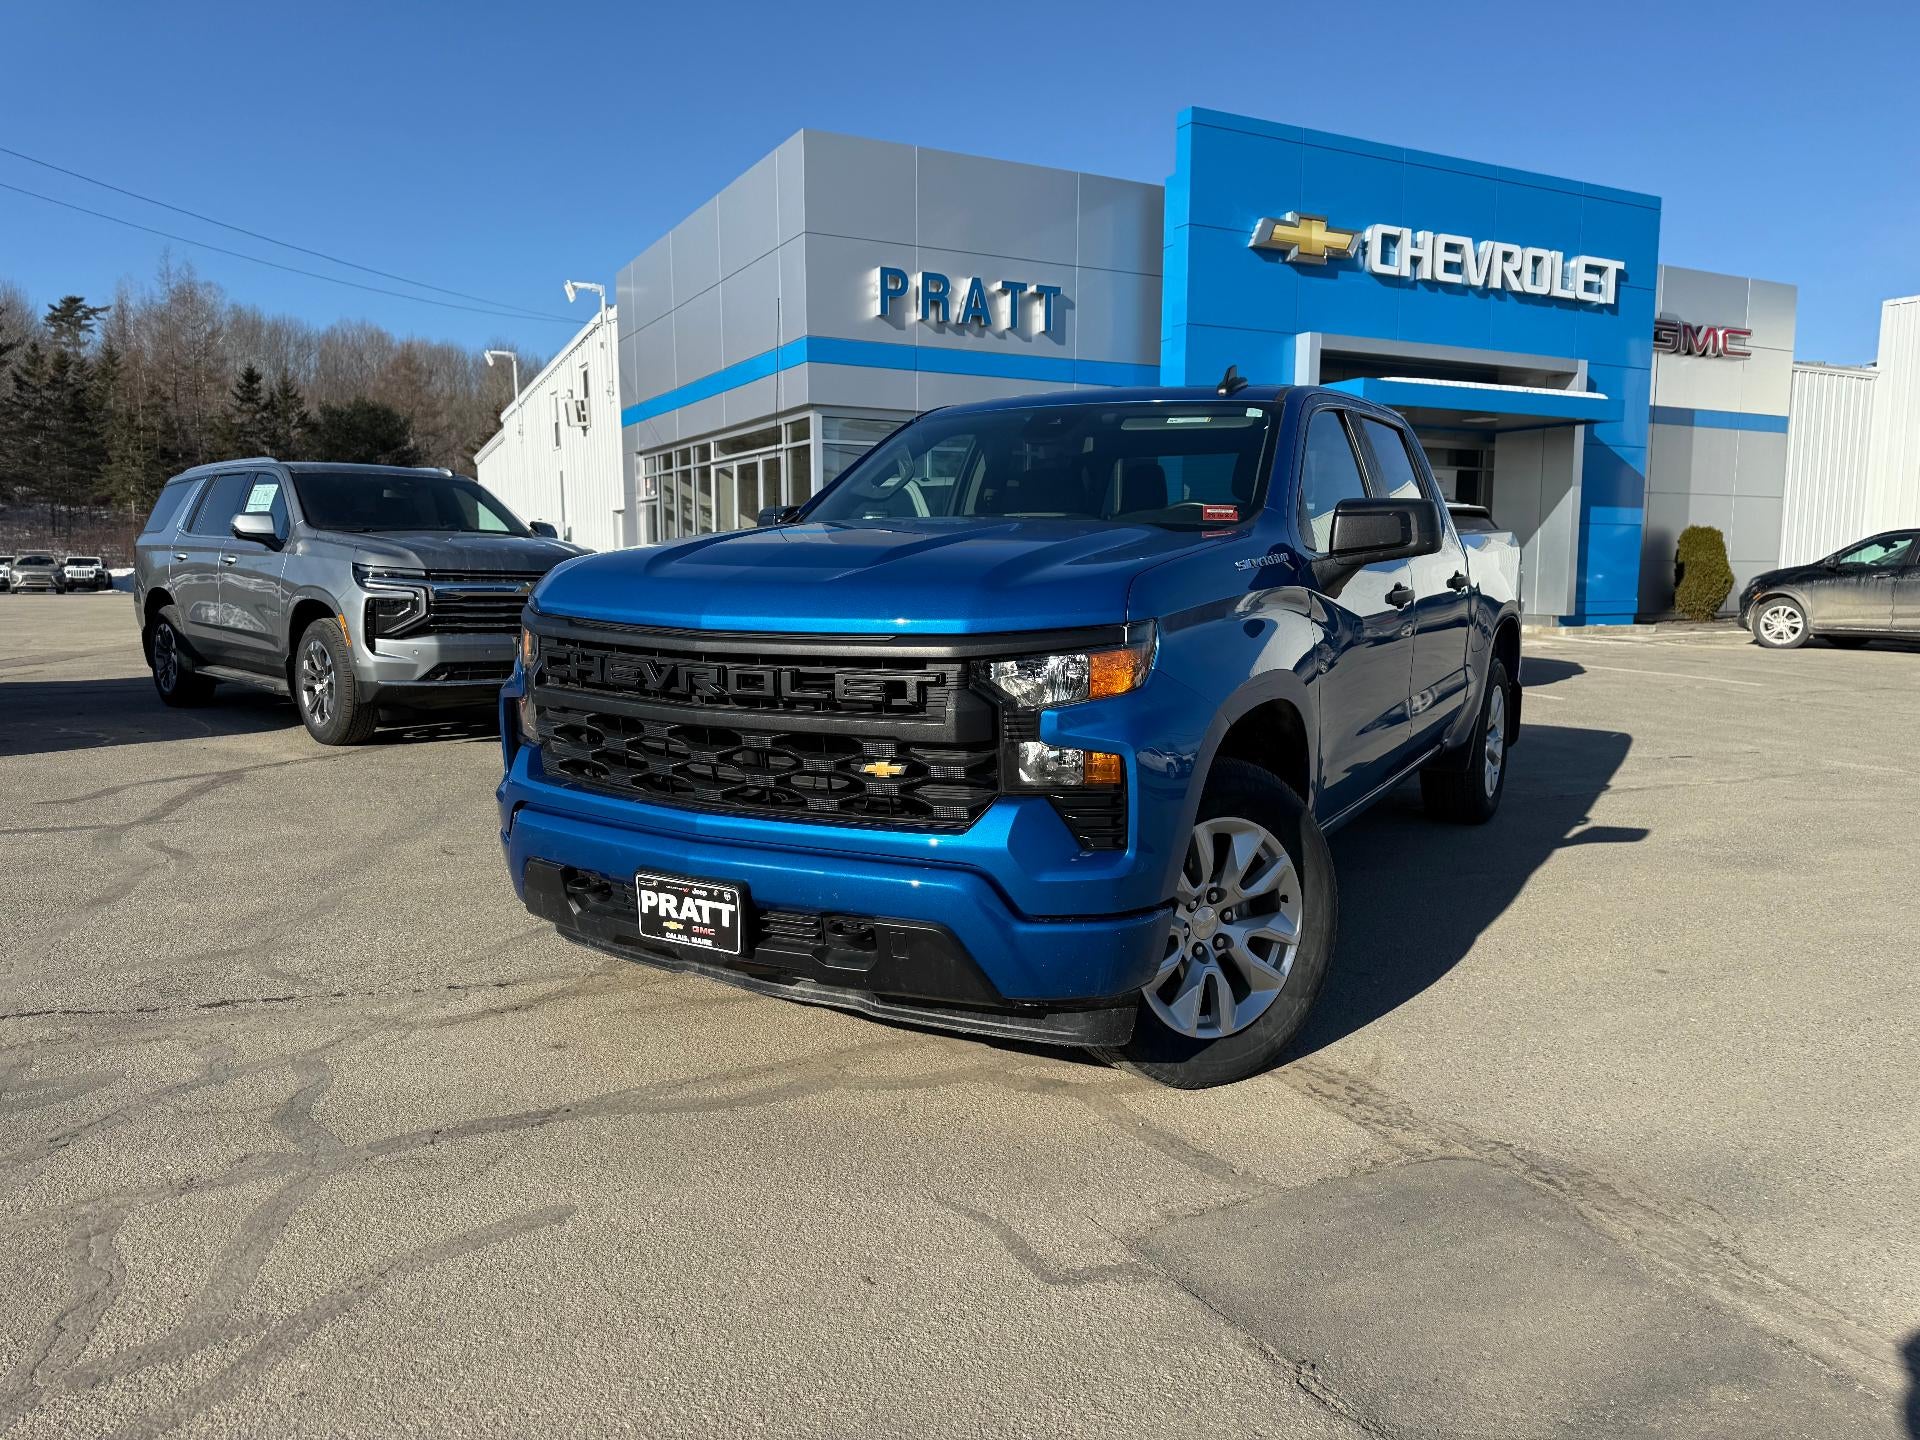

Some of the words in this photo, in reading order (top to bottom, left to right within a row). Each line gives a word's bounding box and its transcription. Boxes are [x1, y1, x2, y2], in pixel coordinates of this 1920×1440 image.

[1364, 223, 1625, 304] CHEVROLET
[872, 265, 1063, 334] PRATT
[1653, 319, 1752, 360] GMC
[538, 650, 947, 707] CHEVROLET
[640, 889, 736, 928] PRATT
[691, 926, 716, 936] GMC
